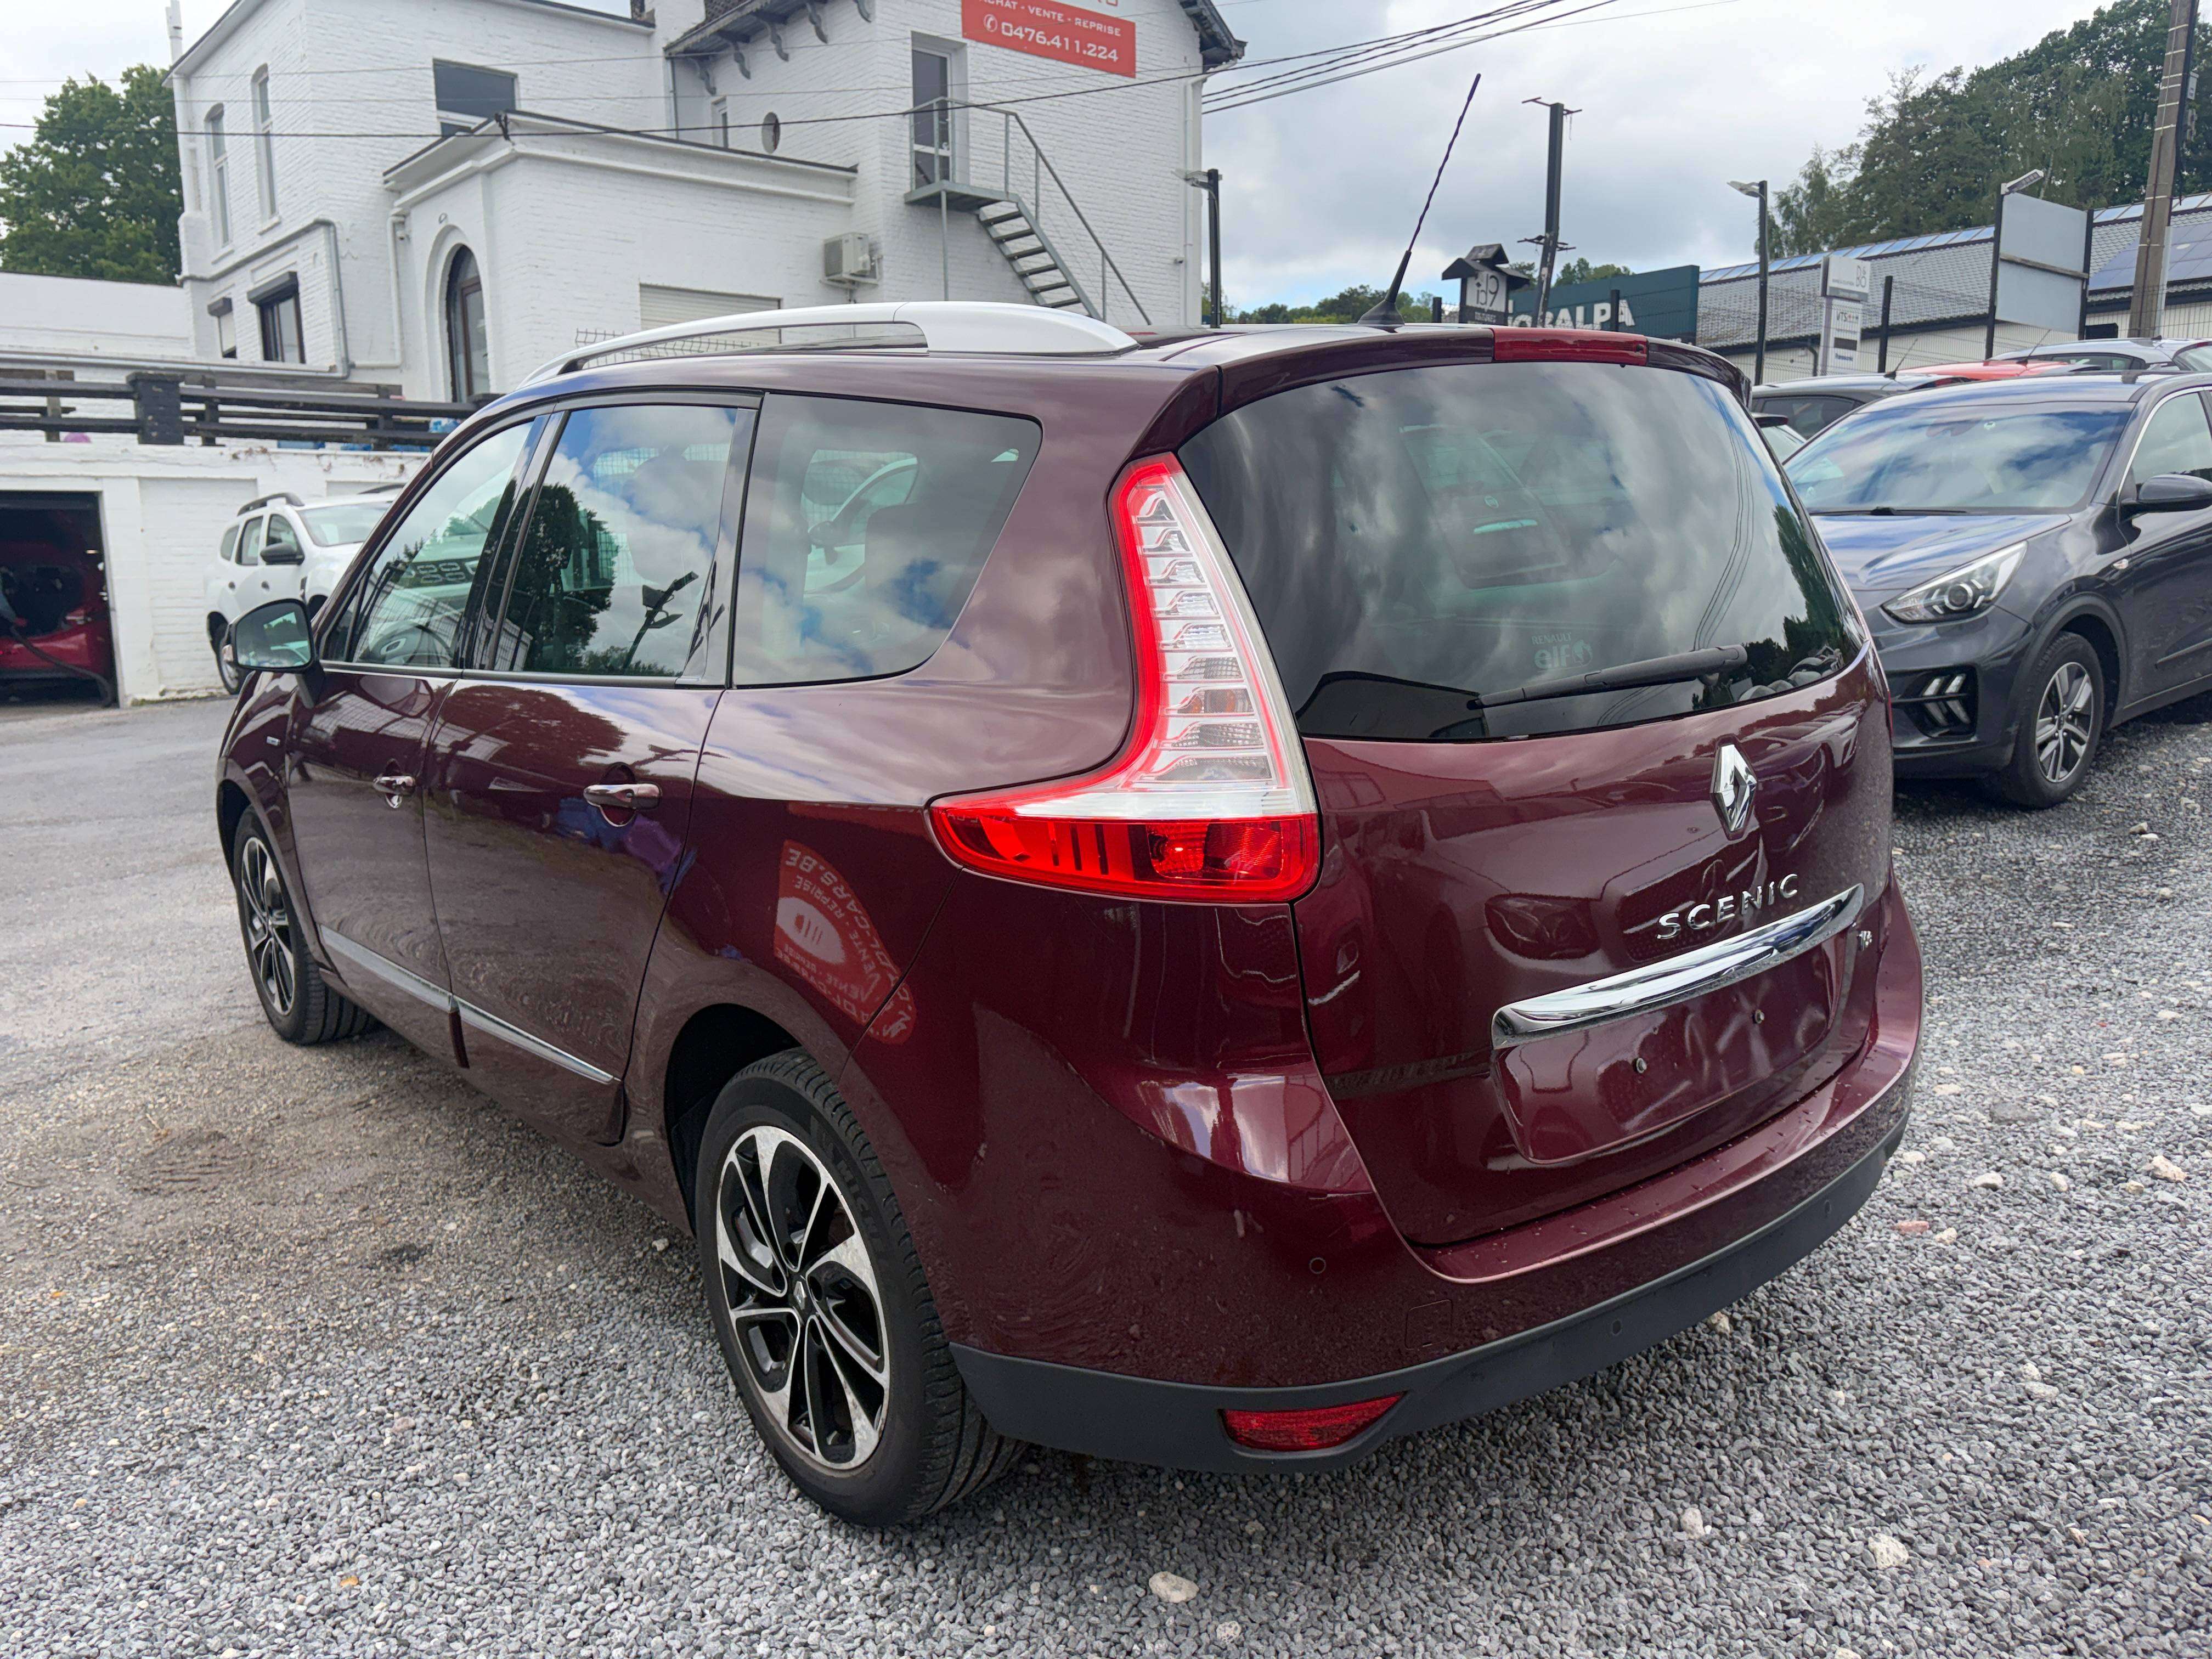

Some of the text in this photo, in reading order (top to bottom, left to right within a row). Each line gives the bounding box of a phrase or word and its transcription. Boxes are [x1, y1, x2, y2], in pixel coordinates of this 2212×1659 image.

[979, 0, 1018, 10] CHAT
[1028, 5, 1064, 22] VENTE
[1074, 17, 1121, 36] REPRISE
[1001, 21, 1119, 63] 0476.411.224
[1531, 631, 1572, 645] RENAULT
[1534, 644, 1570, 669] elf
[1656, 873, 1798, 940] SCENIC
